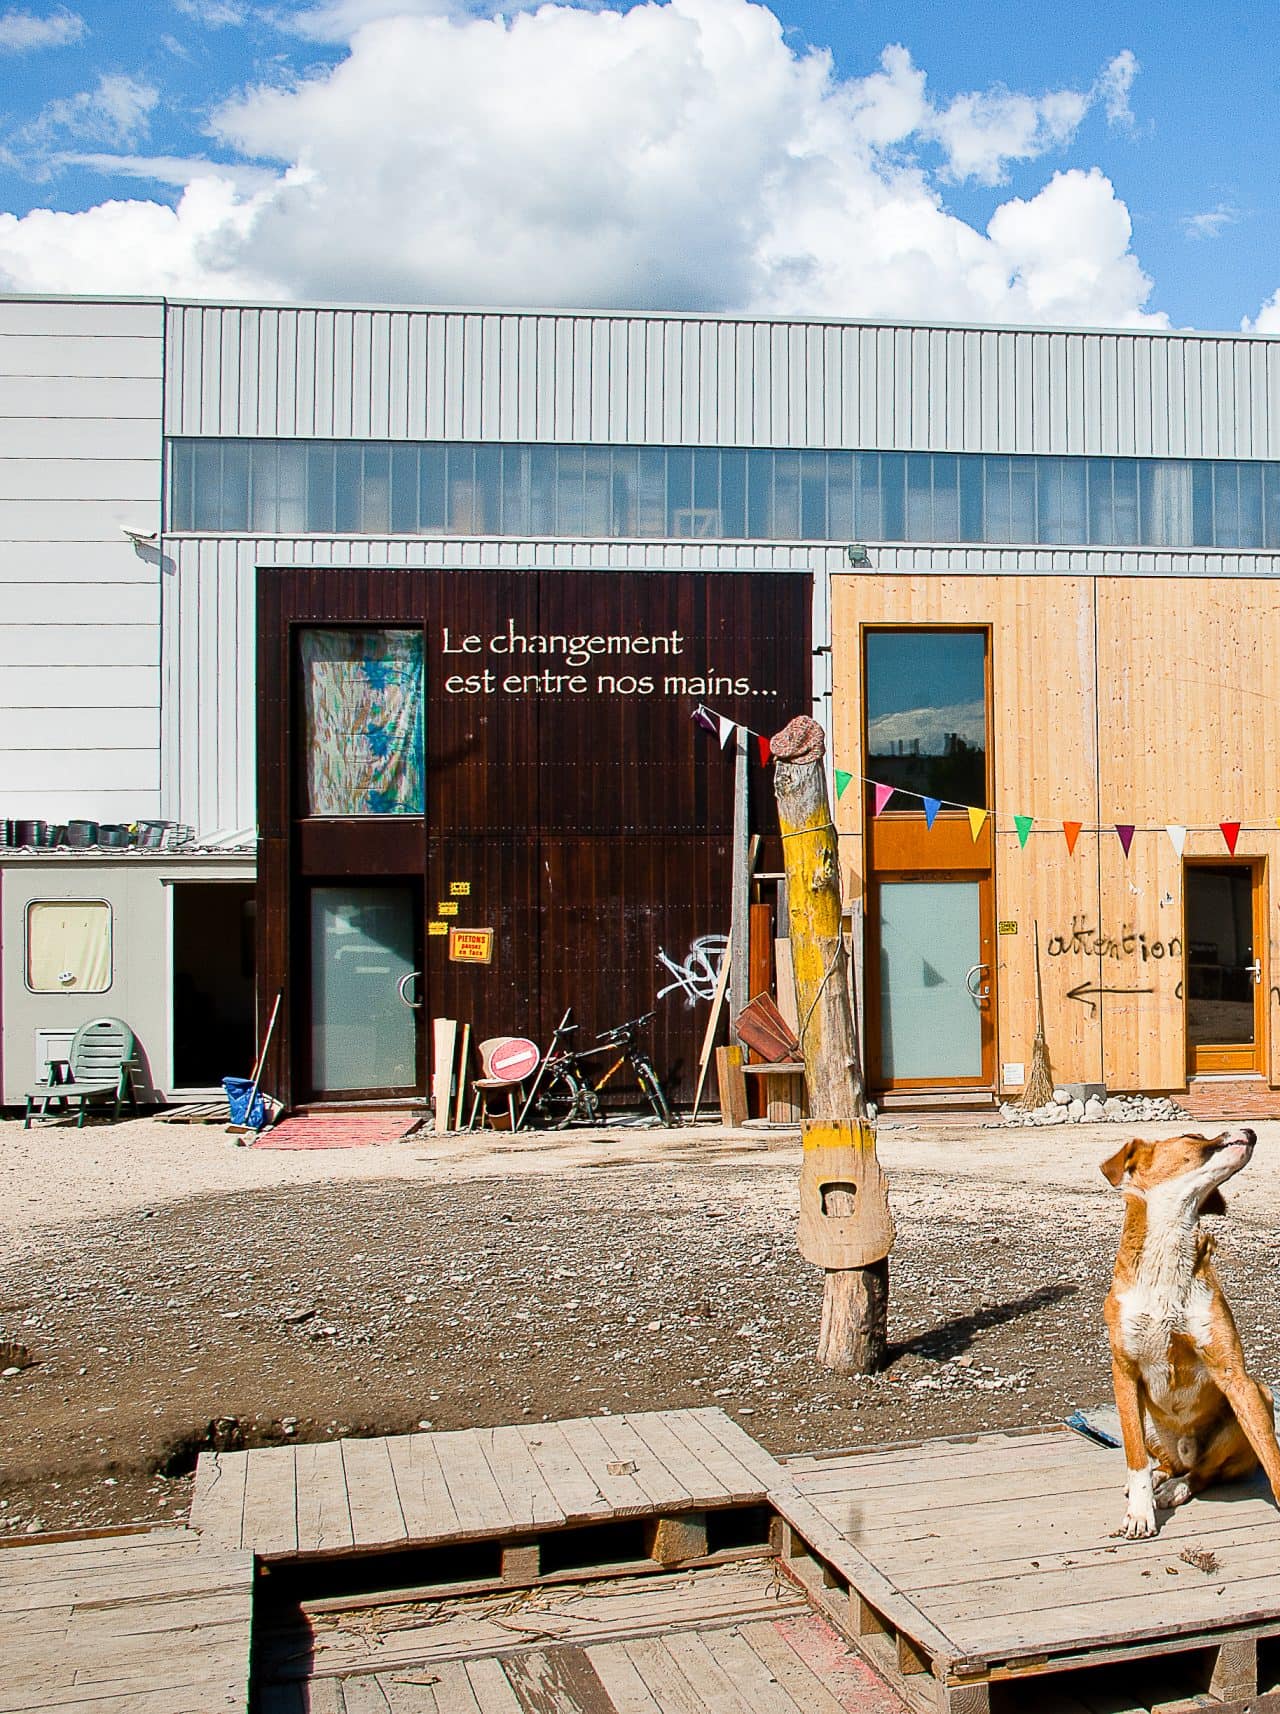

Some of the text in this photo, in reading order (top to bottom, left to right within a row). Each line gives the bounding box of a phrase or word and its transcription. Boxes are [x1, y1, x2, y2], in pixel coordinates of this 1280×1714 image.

[442, 618, 684, 667] Le changement
[444, 668, 778, 696] est entre nos mains...
